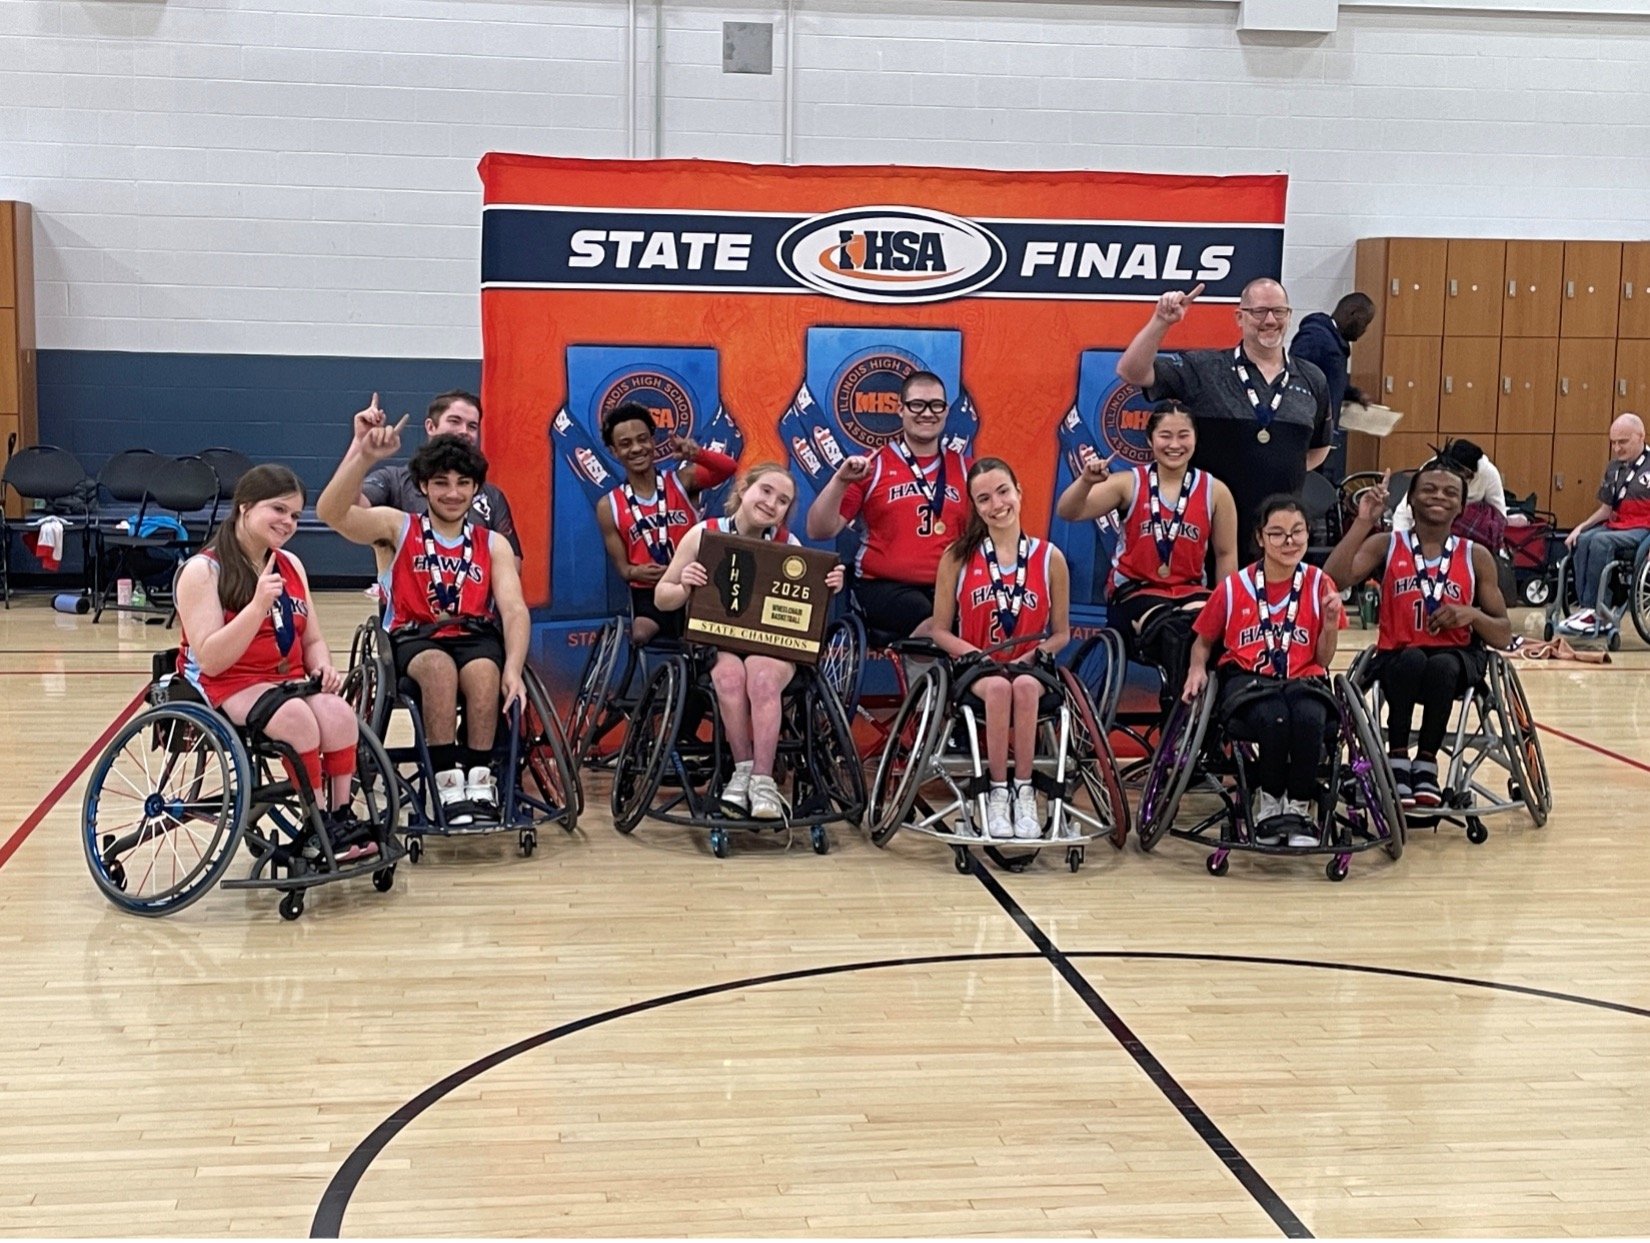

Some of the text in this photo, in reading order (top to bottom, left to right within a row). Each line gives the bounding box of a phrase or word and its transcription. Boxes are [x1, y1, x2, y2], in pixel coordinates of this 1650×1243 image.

[568, 229, 752, 271] STATE
[838, 230, 947, 272] IHSA
[1020, 242, 1235, 281] FINALS
[631, 377, 661, 387] HIGH
[664, 383, 689, 427] SCHOOL
[840, 360, 900, 412] ILLINOIS HIGH
[917, 504, 933, 537] 3
[771, 580, 810, 600] 2026
[701, 622, 808, 648] STATE CHAMPIONS
